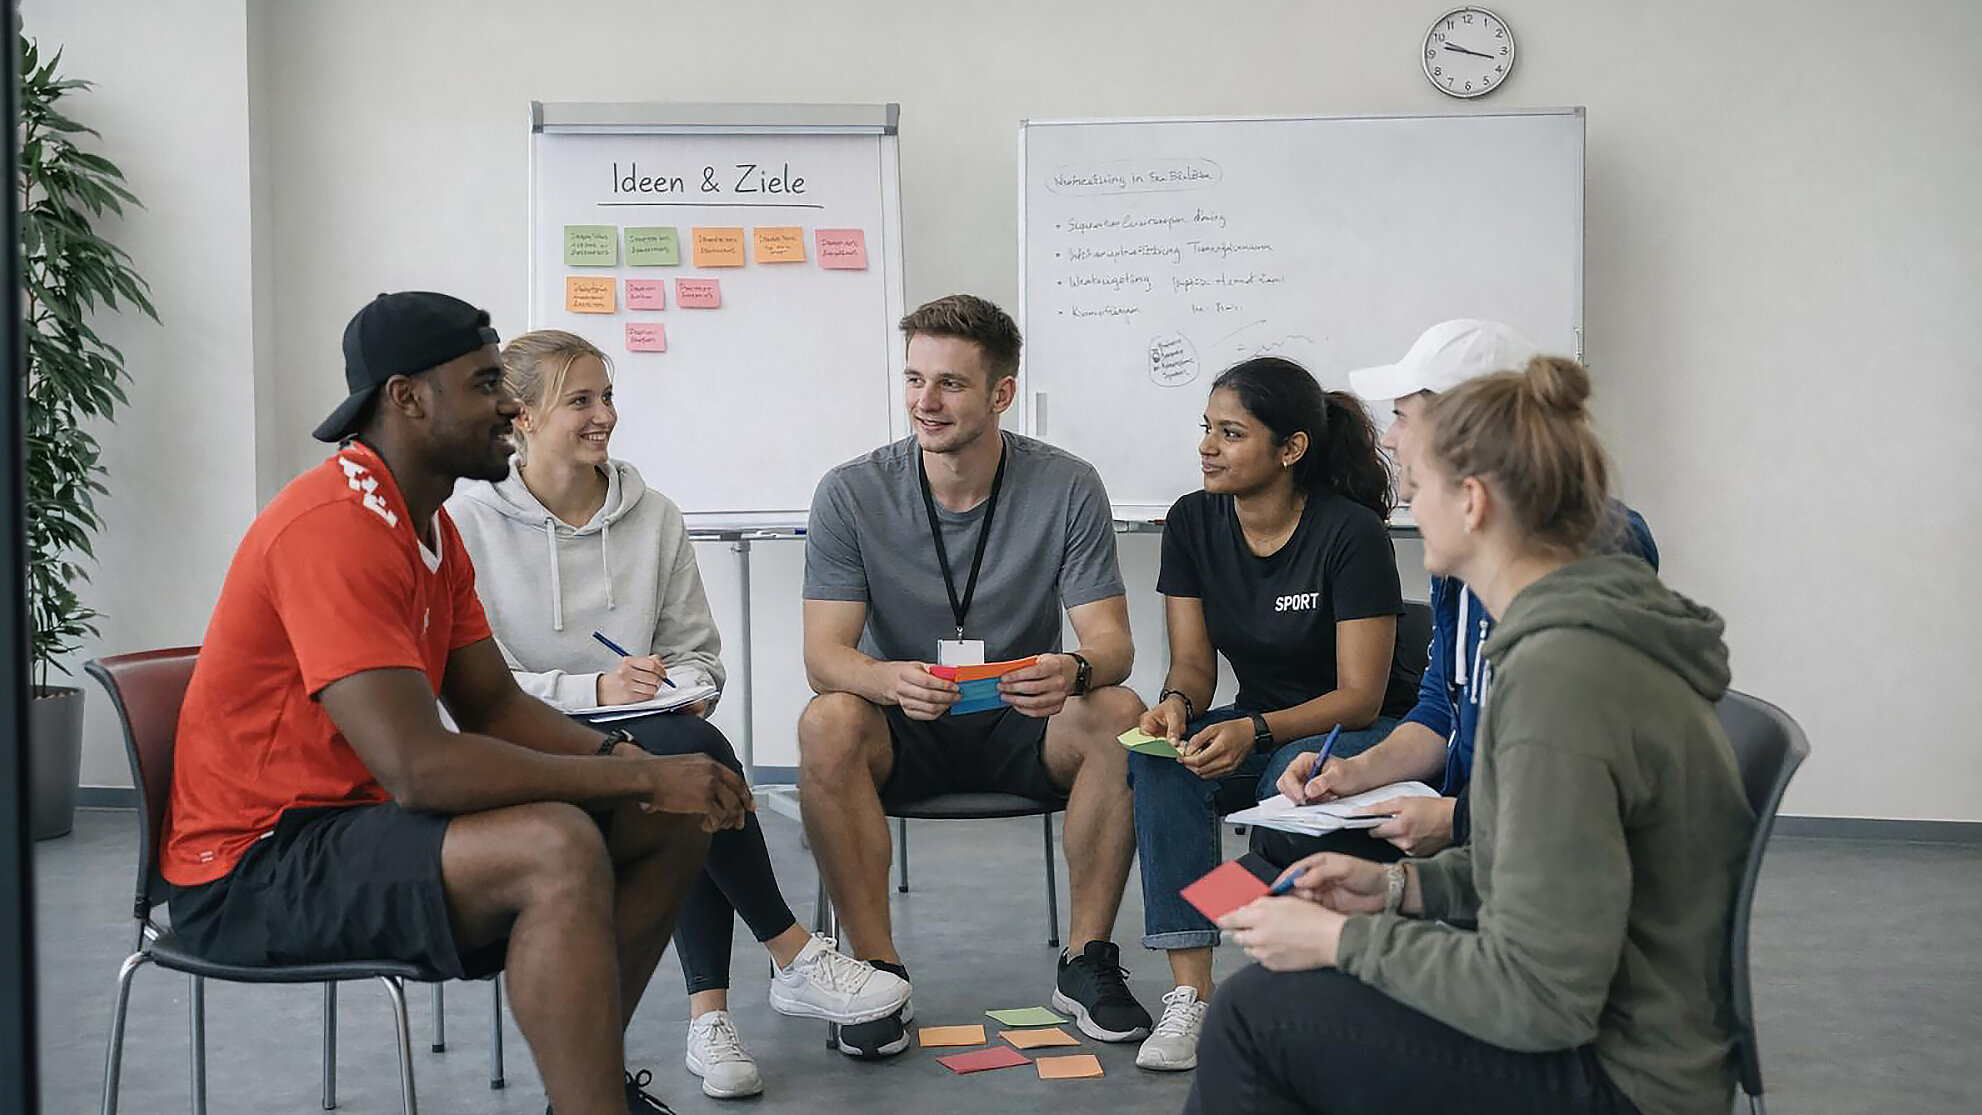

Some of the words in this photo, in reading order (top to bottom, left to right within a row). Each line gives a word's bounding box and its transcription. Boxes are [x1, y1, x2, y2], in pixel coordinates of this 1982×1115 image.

[1462, 14, 1473, 24] 12
[1483, 17, 1488, 27] 1
[1446, 19, 1454, 30] 11
[1433, 32, 1446, 42] 10
[1495, 28, 1504, 38] 2
[1427, 48, 1436, 59] 9
[1499, 46, 1508, 55] 3
[1433, 66, 1441, 76] 8
[1494, 64, 1503, 72] 4
[1447, 77, 1454, 87] 7
[1464, 80, 1472, 91] 6
[1483, 75, 1490, 86] 5
[613, 162, 685, 194] Ideen
[700, 166, 720, 193] &
[734, 163, 807, 194] Ziele
[1275, 592, 1319, 612] SPORT
